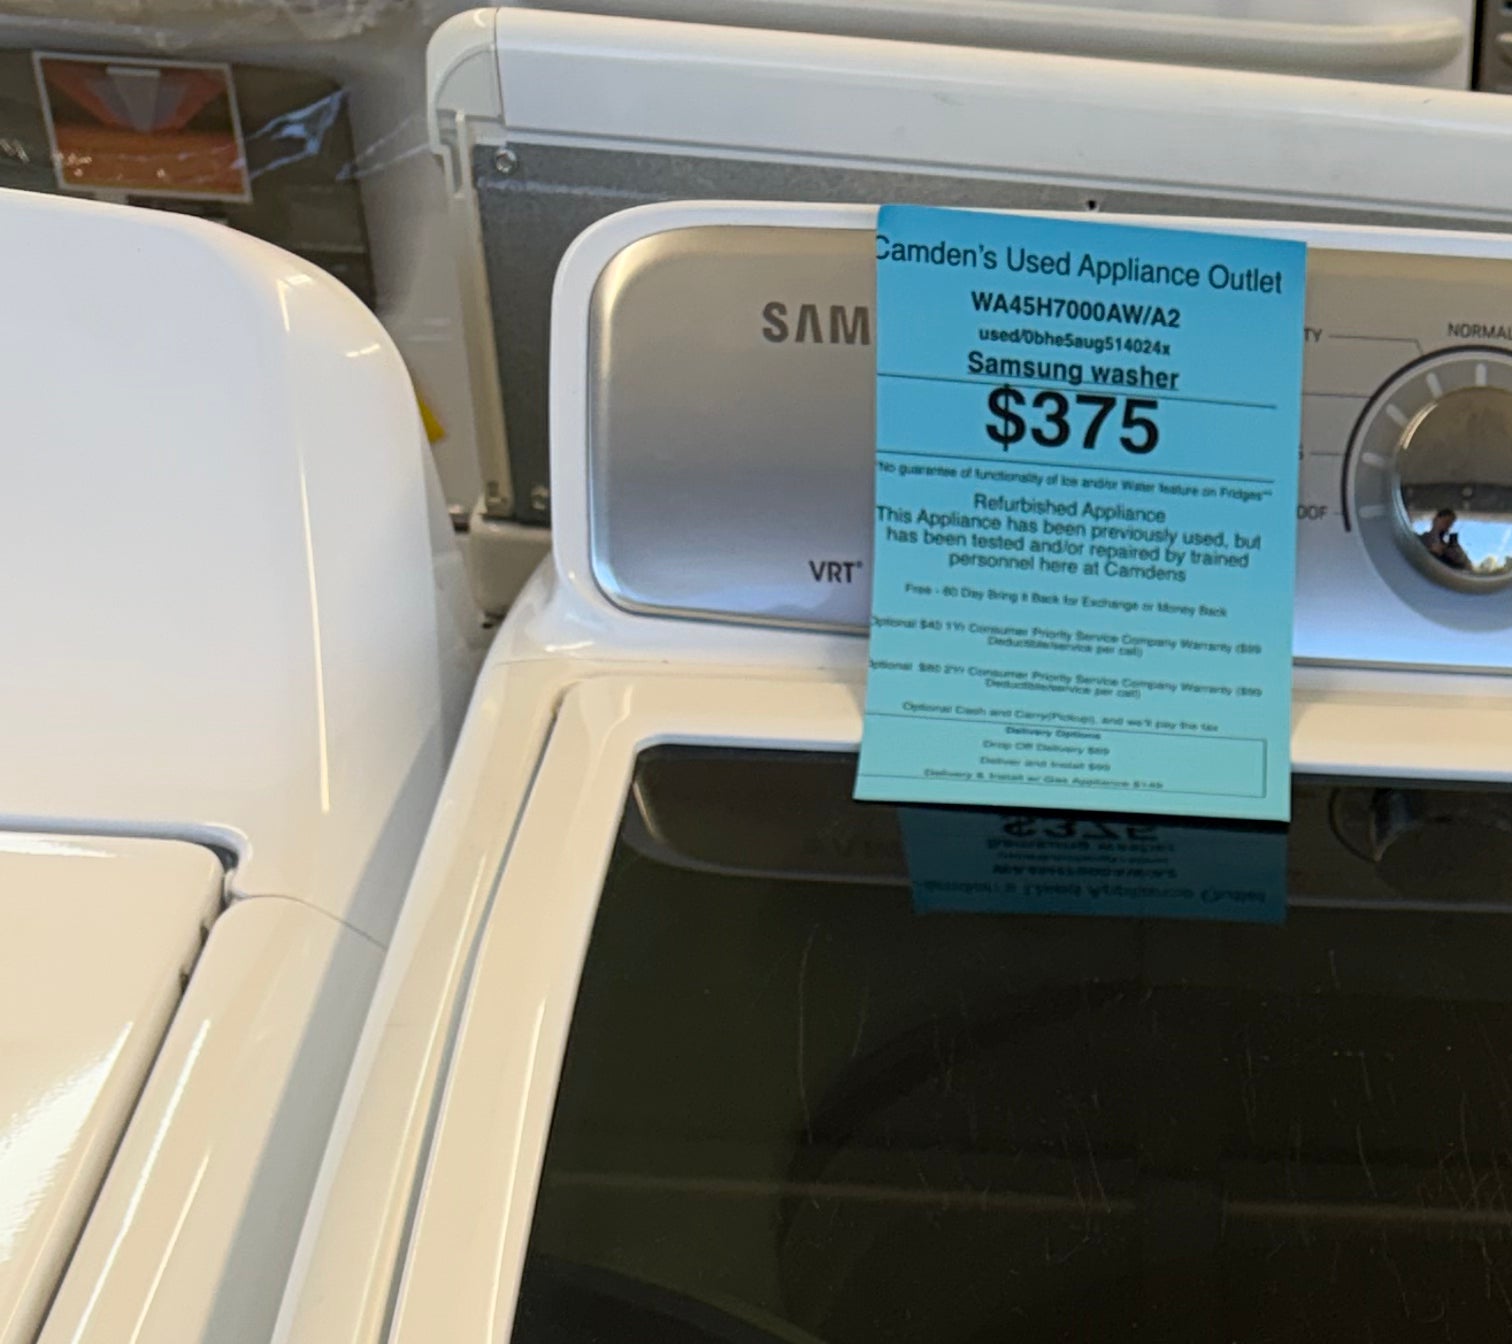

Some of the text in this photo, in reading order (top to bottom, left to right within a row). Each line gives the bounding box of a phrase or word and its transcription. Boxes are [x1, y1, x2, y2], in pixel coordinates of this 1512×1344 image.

[876, 234, 1283, 294] Camden's Used Appliance Outlet
[971, 291, 1180, 328] WA45H7000AW/A2
[968, 351, 1180, 390] Samsung washer
[985, 383, 1160, 455] $375
[974, 492, 1166, 523] Refurbished Appliance
[1121, 479, 1156, 494] Water
[1159, 482, 1199, 497] feature
[1203, 486, 1217, 497] on
[876, 504, 913, 525] This
[917, 508, 1002, 530] Appliance
[1007, 516, 1039, 534] has
[1043, 518, 1087, 537] been
[1091, 525, 1178, 549] previously
[1235, 532, 1262, 551] but
[886, 525, 1250, 569] has been tested and/or repaired by trained
[949, 552, 1187, 583] personnel here at Camdens
